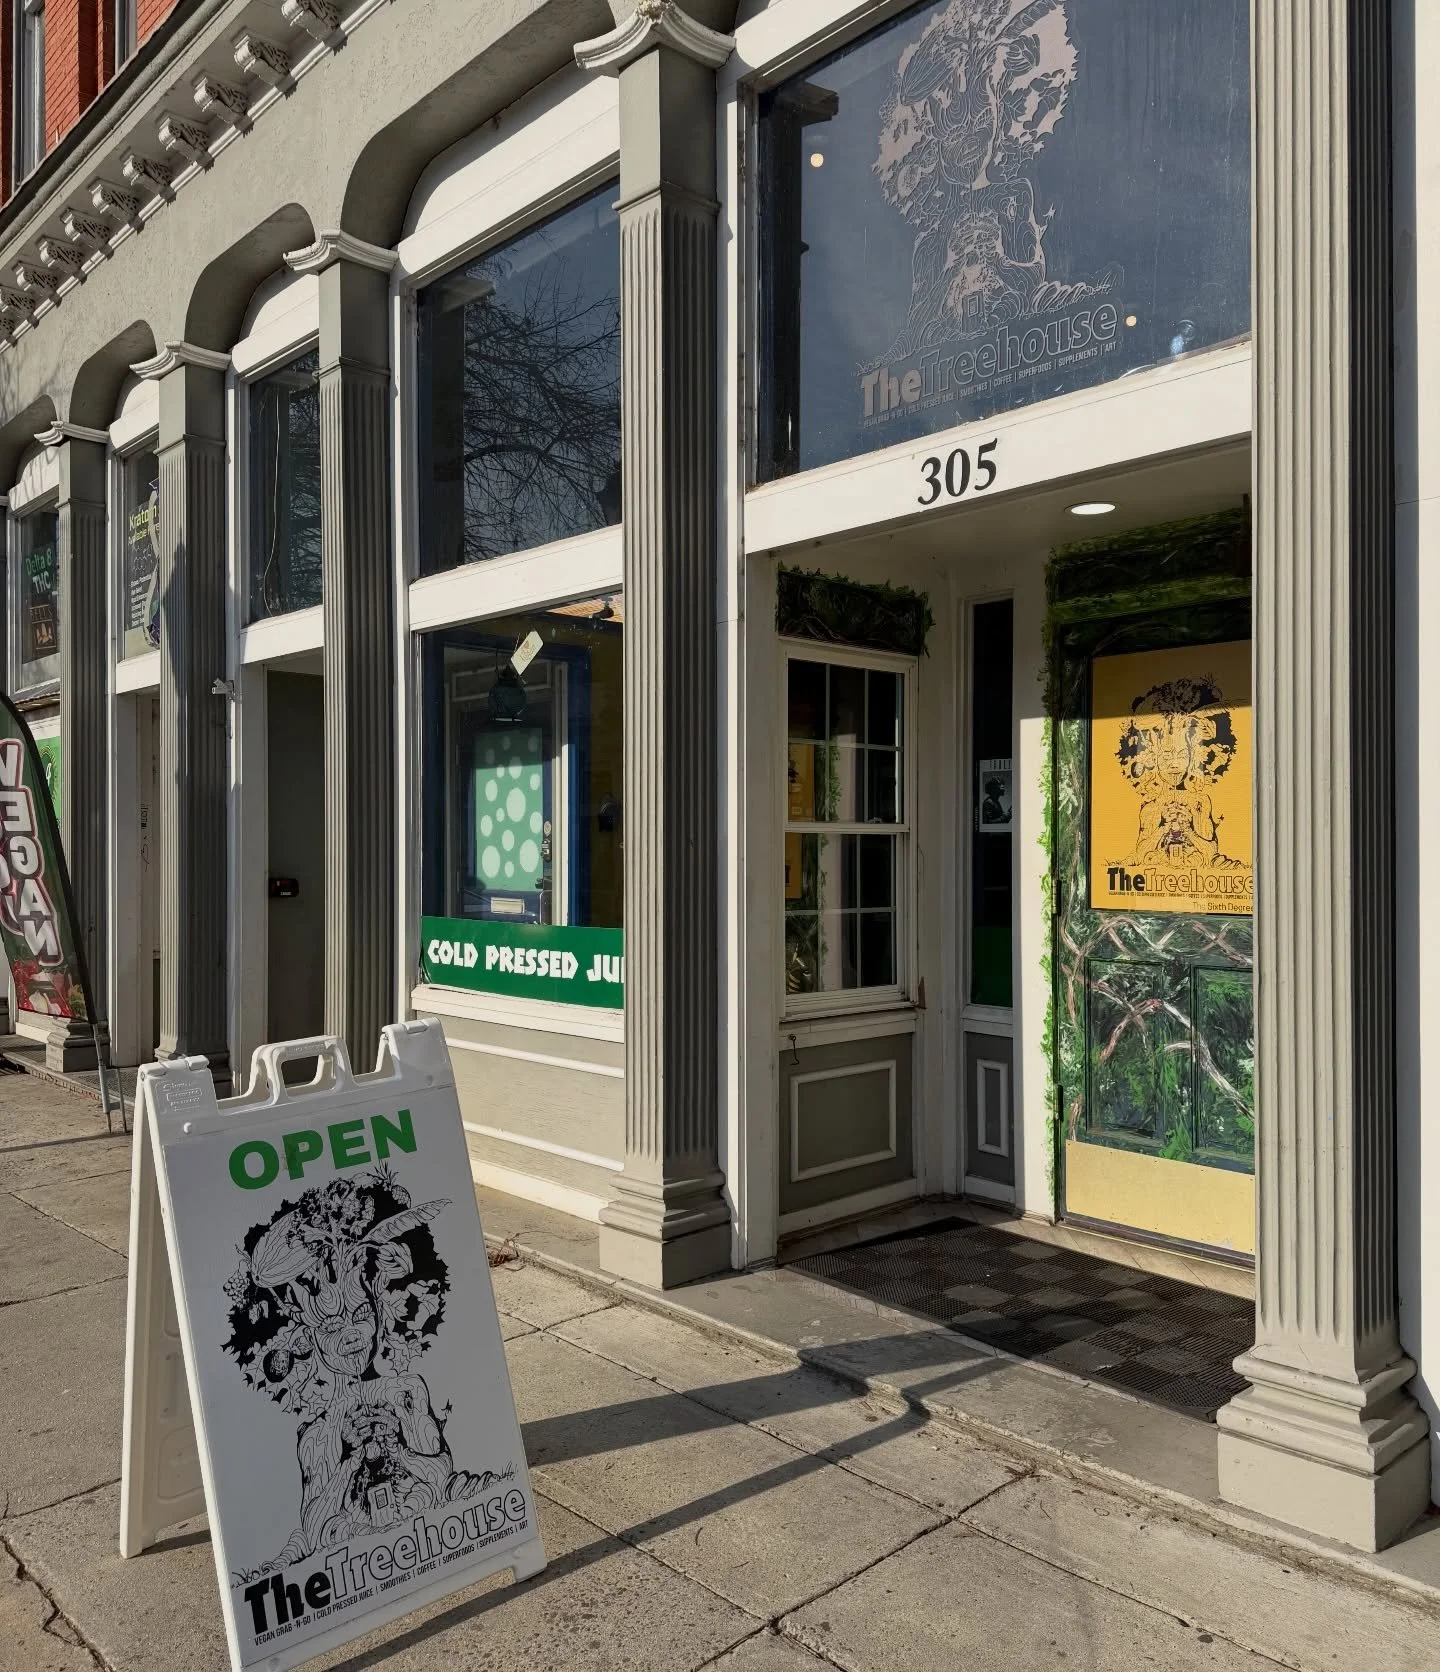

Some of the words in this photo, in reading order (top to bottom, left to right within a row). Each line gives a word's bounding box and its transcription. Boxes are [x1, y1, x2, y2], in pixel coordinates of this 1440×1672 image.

[959, 380, 989, 398] SMOOTHIES
[993, 372, 1013, 388] COFFEE
[1018, 361, 1052, 380] SUPERFOODS
[1058, 346, 1098, 367] SUPPLEMENTS
[1104, 341, 1117, 354] ART
[917, 437, 998, 506] 305
[25, 554, 45, 576] Delta
[46, 548, 52, 566] 8
[32, 570, 52, 594] THC
[1207, 902, 1227, 911] Sixth
[427, 939, 479, 969] COLD
[485, 944, 579, 980] PRESSED
[228, 1109, 418, 1190] OPEN
[253, 1633, 276, 1647] VEGAN
[275, 1623, 293, 1637] GRAB
[316, 1607, 332, 1620] COLD
[332, 1594, 358, 1613] PRESSED
[358, 1588, 374, 1602] JUICE
[379, 1571, 411, 1592] SMOOTHIES
[417, 1560, 437, 1576] COFFEE
[442, 1542, 476, 1565] SUPERFOODS
[479, 1526, 514, 1549] SUPPLEMENTS
[519, 1519, 529, 1532] ART
